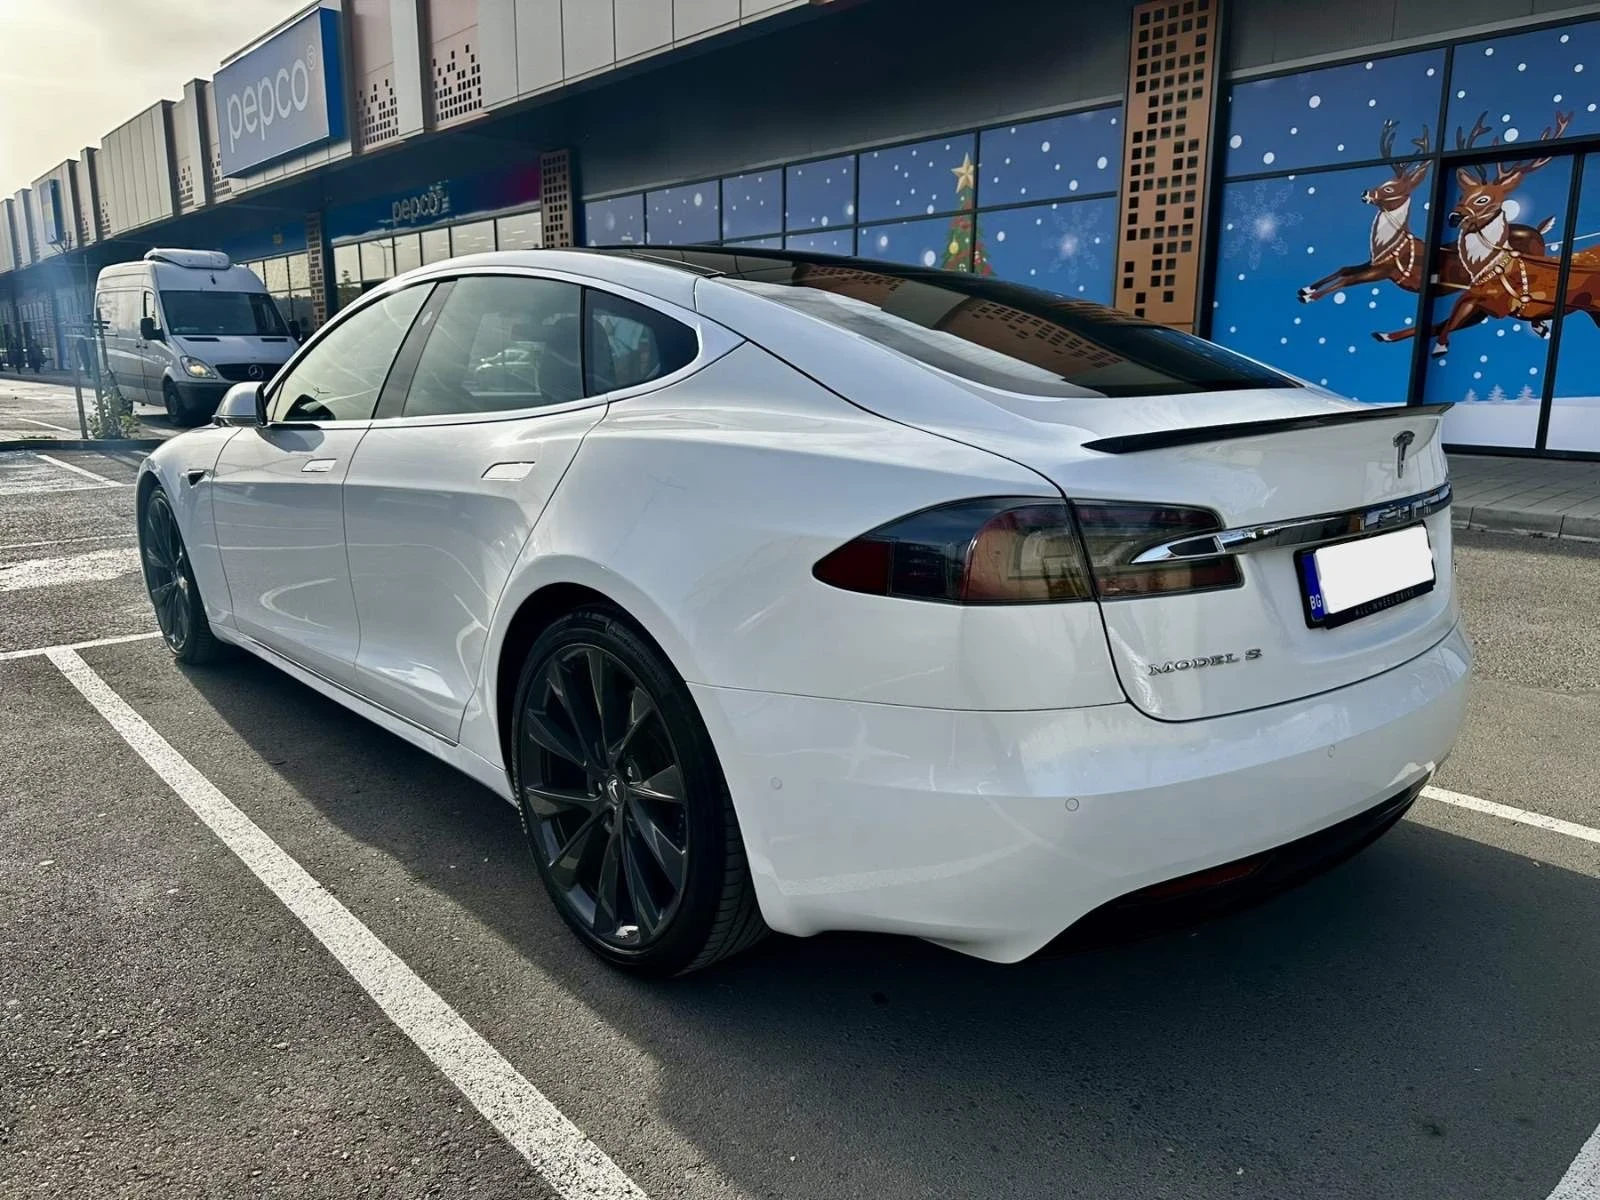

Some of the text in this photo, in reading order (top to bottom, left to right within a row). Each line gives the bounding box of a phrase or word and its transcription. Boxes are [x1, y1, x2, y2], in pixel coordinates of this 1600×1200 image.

[226, 58, 309, 154] pepco
[1309, 594, 1322, 610] BG
[1148, 648, 1263, 676] MODEL S
